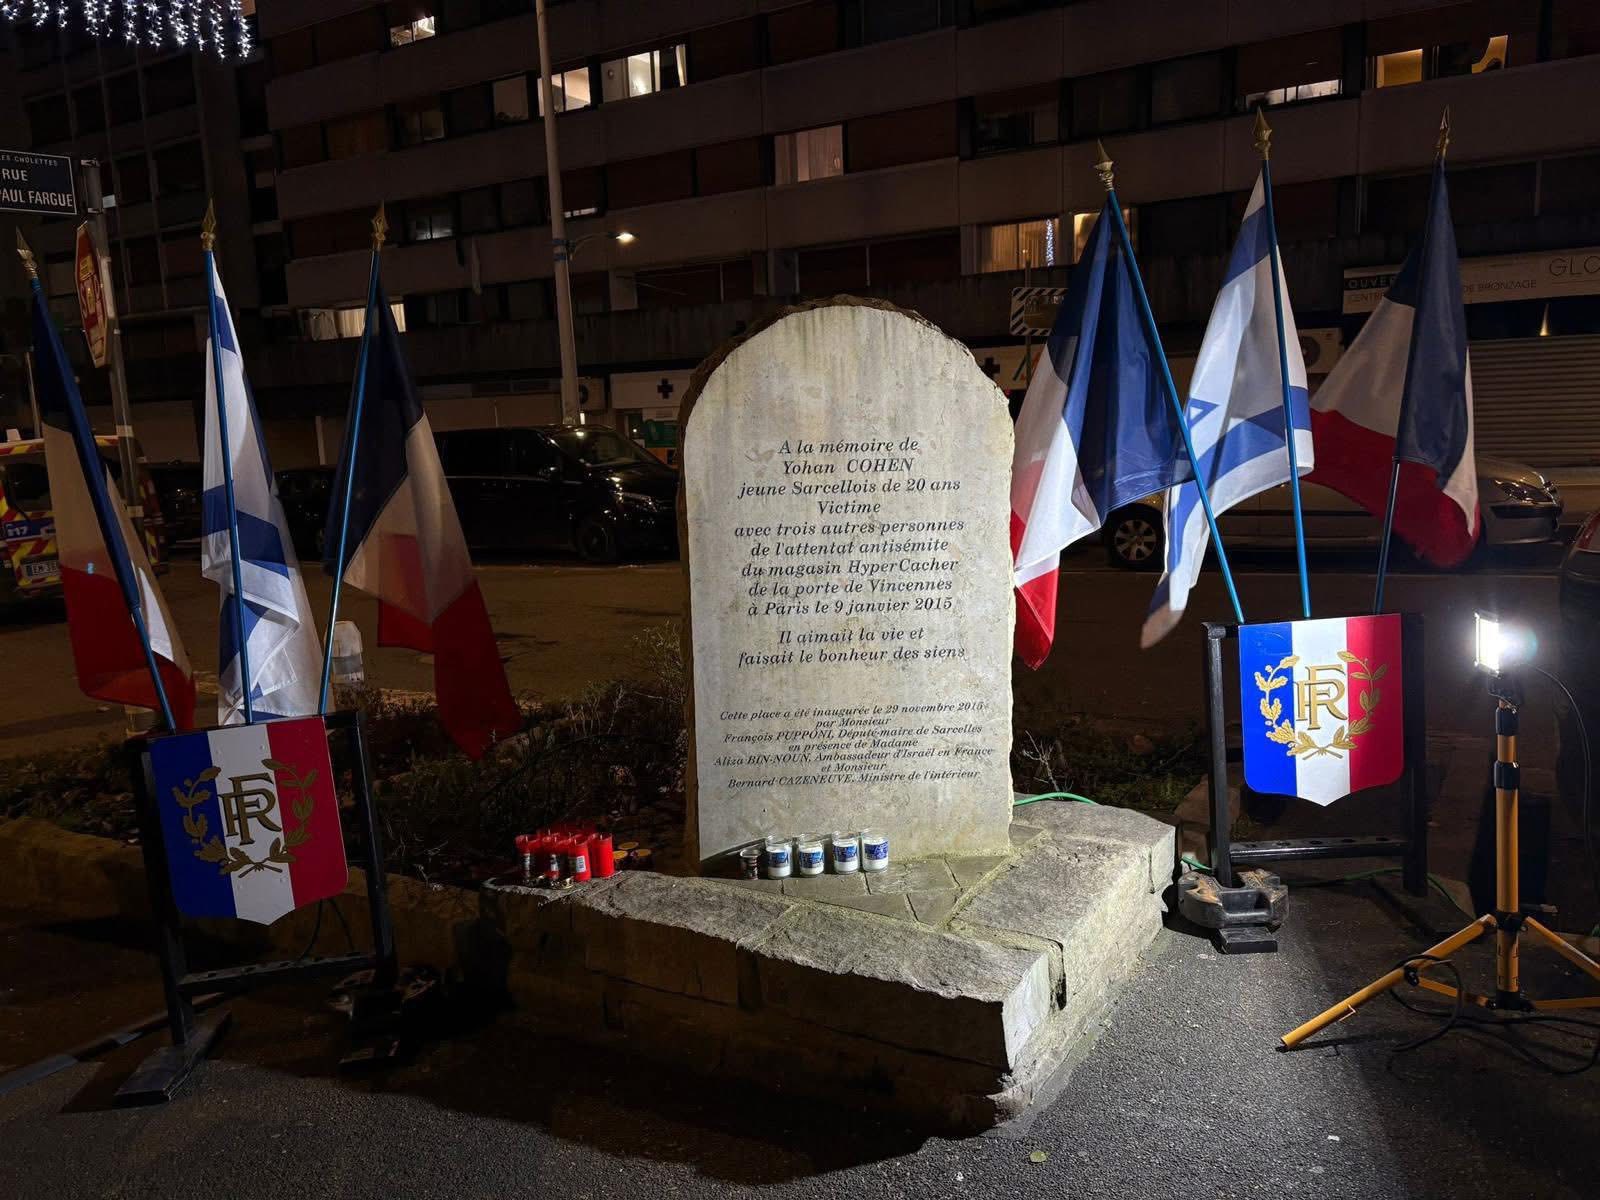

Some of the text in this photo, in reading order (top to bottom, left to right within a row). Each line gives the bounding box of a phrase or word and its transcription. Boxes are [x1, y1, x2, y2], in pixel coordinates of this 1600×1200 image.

[2, 168, 28, 181] RUE
[0, 188, 73, 207] AUL FARGUE
[778, 437, 919, 454] A la mémoire de
[783, 458, 914, 475] Yohan COHEN
[737, 479, 960, 499] jeune Sarcellois de 20 ans
[818, 501, 881, 515] Victime
[734, 520, 964, 537] avec trois autres personnes
[751, 539, 948, 557] de l'attentat antisémite
[742, 559, 958, 579] du magasin HyperCacher
[749, 578, 952, 597] de la porte de Vincennes
[748, 597, 952, 616] à Paris le 9 janvier 2015
[778, 627, 924, 644] Il aimait la vie et
[738, 646, 965, 668] faisait le bonheur des siens
[720, 711, 748, 721] Cette
[751, 709, 782, 720] place
[794, 708, 810, 717] été
[812, 706, 870, 718] inaugurée
[873, 705, 883, 714] le
[885, 705, 898, 714] 29
[901, 703, 955, 713] novembre
[957, 702, 984, 711] 2015
[816, 717, 891, 729] par Monsieur
[724, 725, 982, 744] François PUPPONI, Député-maire de Sarcelles
[788, 738, 919, 752] en présence de Madame
[713, 756, 745, 767] Aliza
[747, 754, 811, 766] BIN-NOUN,
[814, 751, 890, 762] Ambassadeur
[893, 748, 934, 758] d'Israël
[955, 746, 992, 755] France
[821, 762, 887, 772] et Monsieur
[728, 769, 979, 788] Bernard CAZENEUVE, Ministre de l'intérieur
